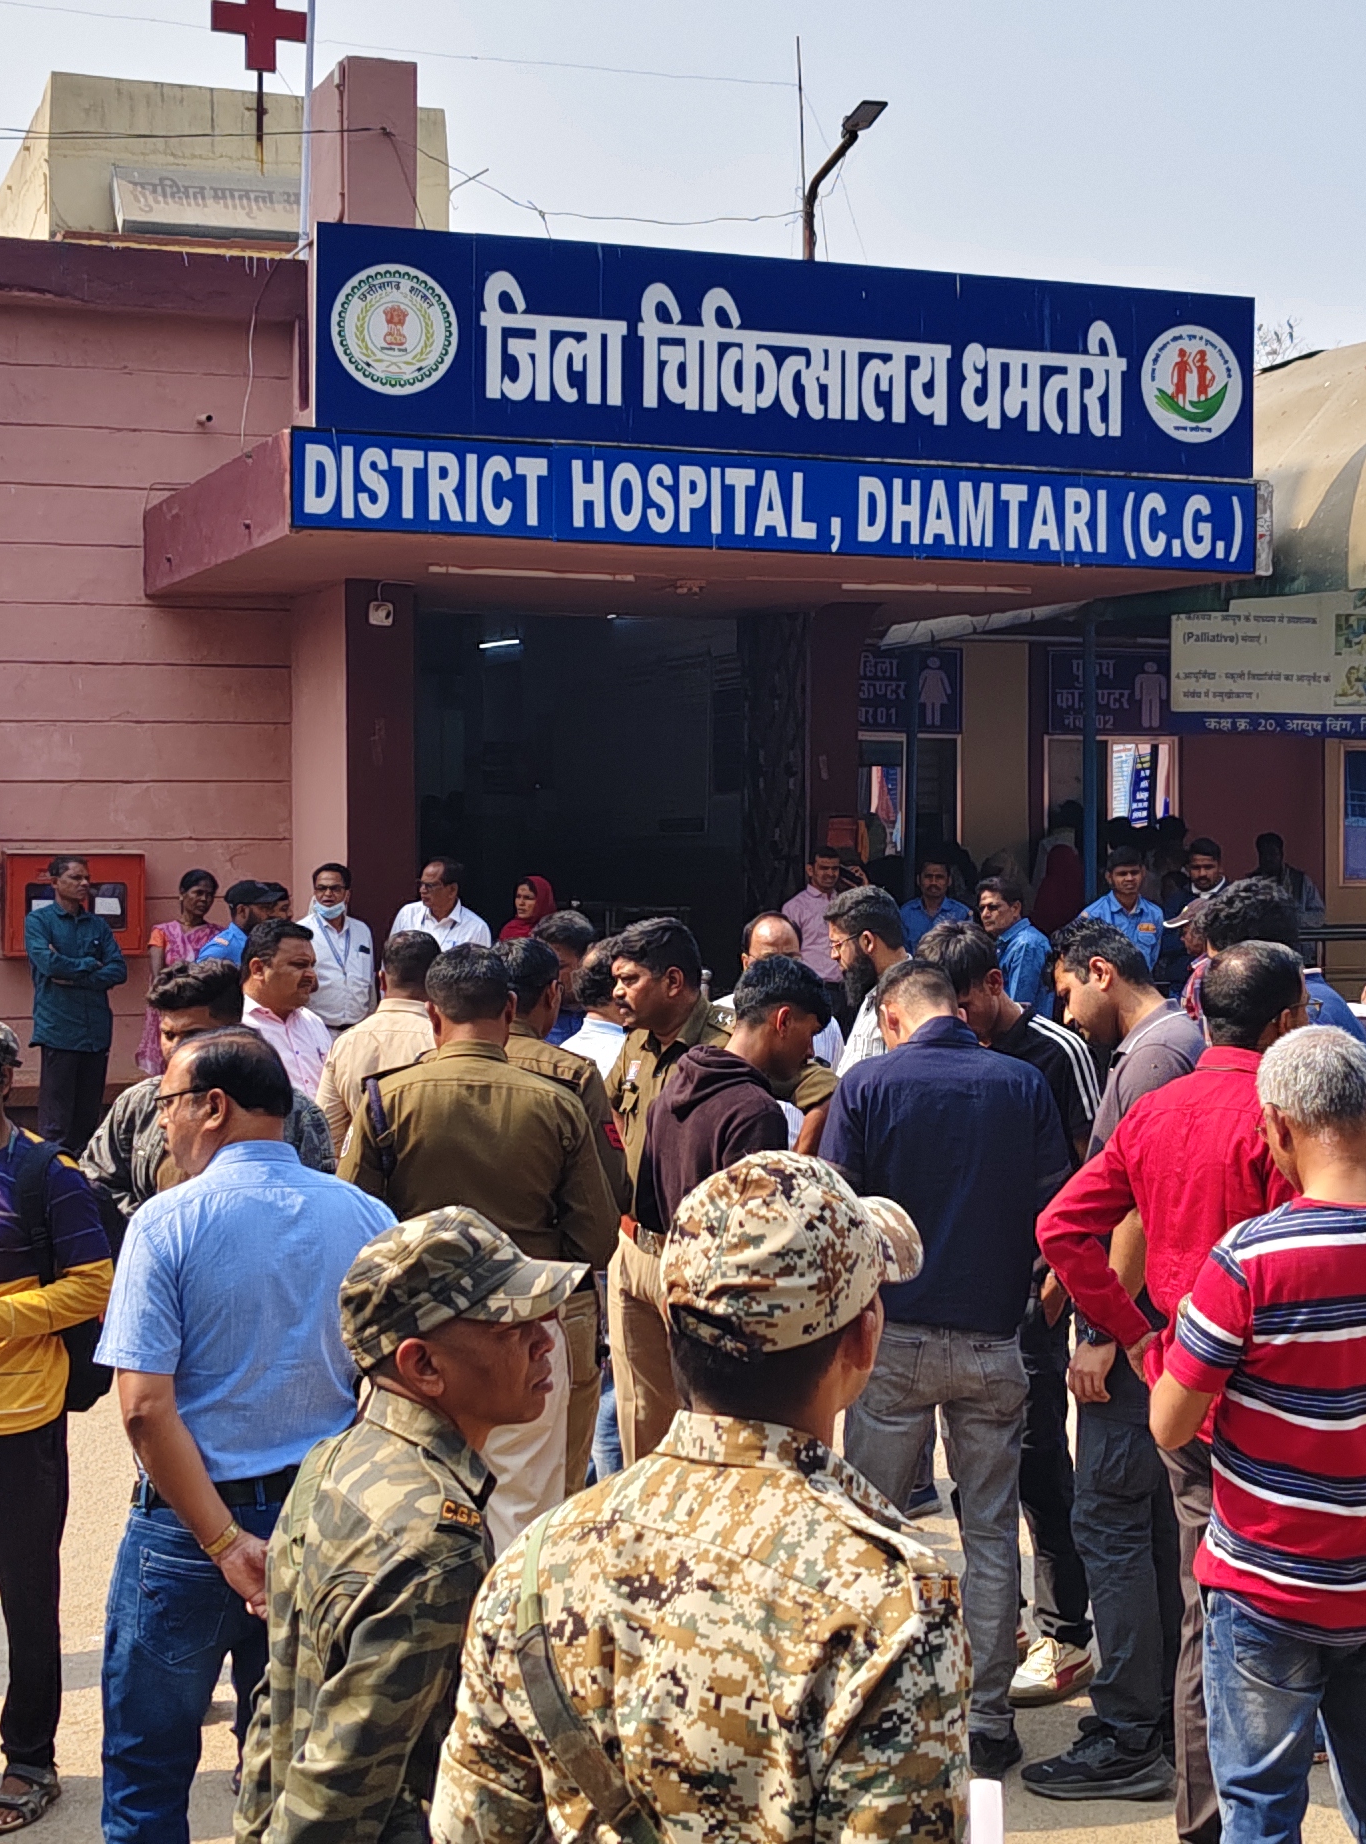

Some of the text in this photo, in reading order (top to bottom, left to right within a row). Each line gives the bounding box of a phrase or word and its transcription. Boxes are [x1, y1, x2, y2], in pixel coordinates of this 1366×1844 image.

[132, 177, 207, 213] सुरक्षित
[210, 186, 275, 218] मातृत्व
[408, 285, 435, 309] शासन
[480, 271, 1128, 437] जिला चिकित्सालय धमतरी
[303, 444, 549, 527] DISTRICT
[857, 477, 1108, 552] DHAMTARI
[1123, 489, 1244, 562] (C.G.)
[1182, 631, 1239, 645] (Palliative)
[858, 651, 898, 678] हिला
[1204, 716, 1233, 732] कक्ष
[1235, 717, 1254, 732] क्र.
[1258, 718, 1281, 733] 20,
[1285, 718, 1322, 736] आयुष
[1326, 715, 1356, 734] विंग,
